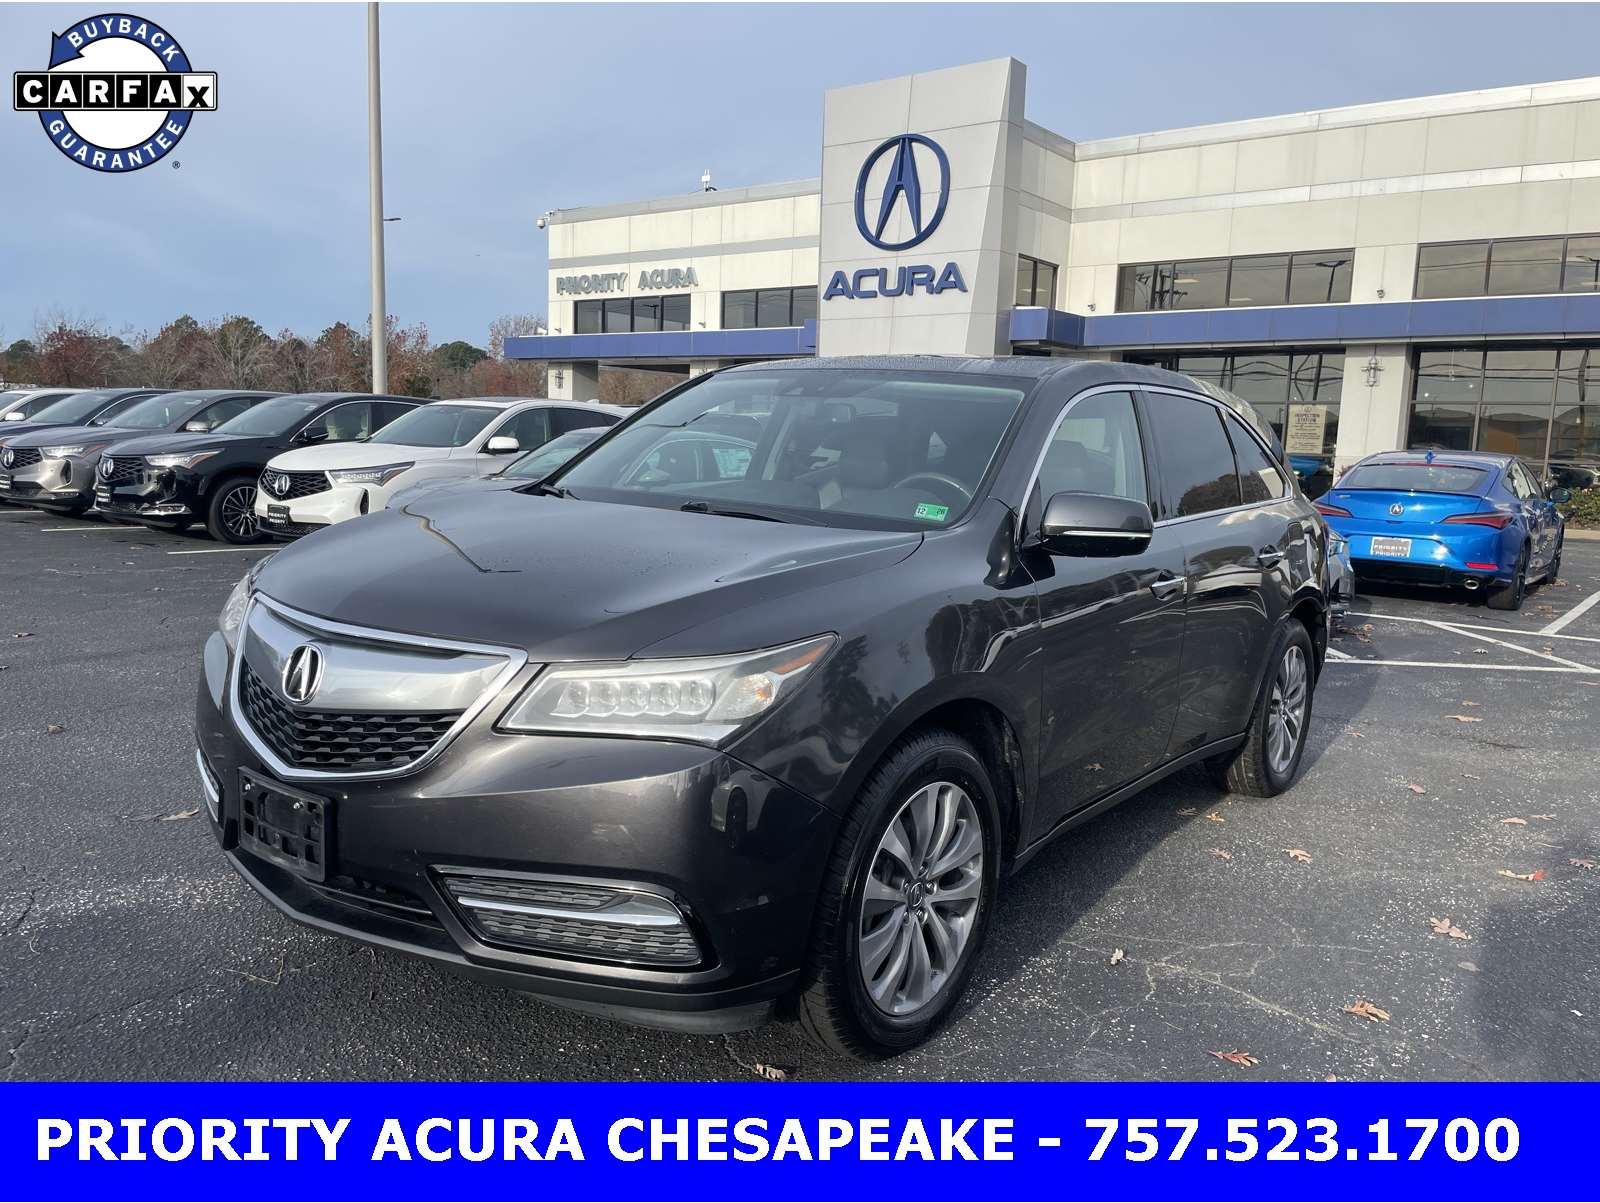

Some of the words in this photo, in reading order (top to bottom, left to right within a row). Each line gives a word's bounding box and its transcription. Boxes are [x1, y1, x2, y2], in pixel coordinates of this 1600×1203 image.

[556, 272, 628, 295] PRIORITY
[638, 267, 699, 290] ACURA
[822, 262, 968, 301] ACURA
